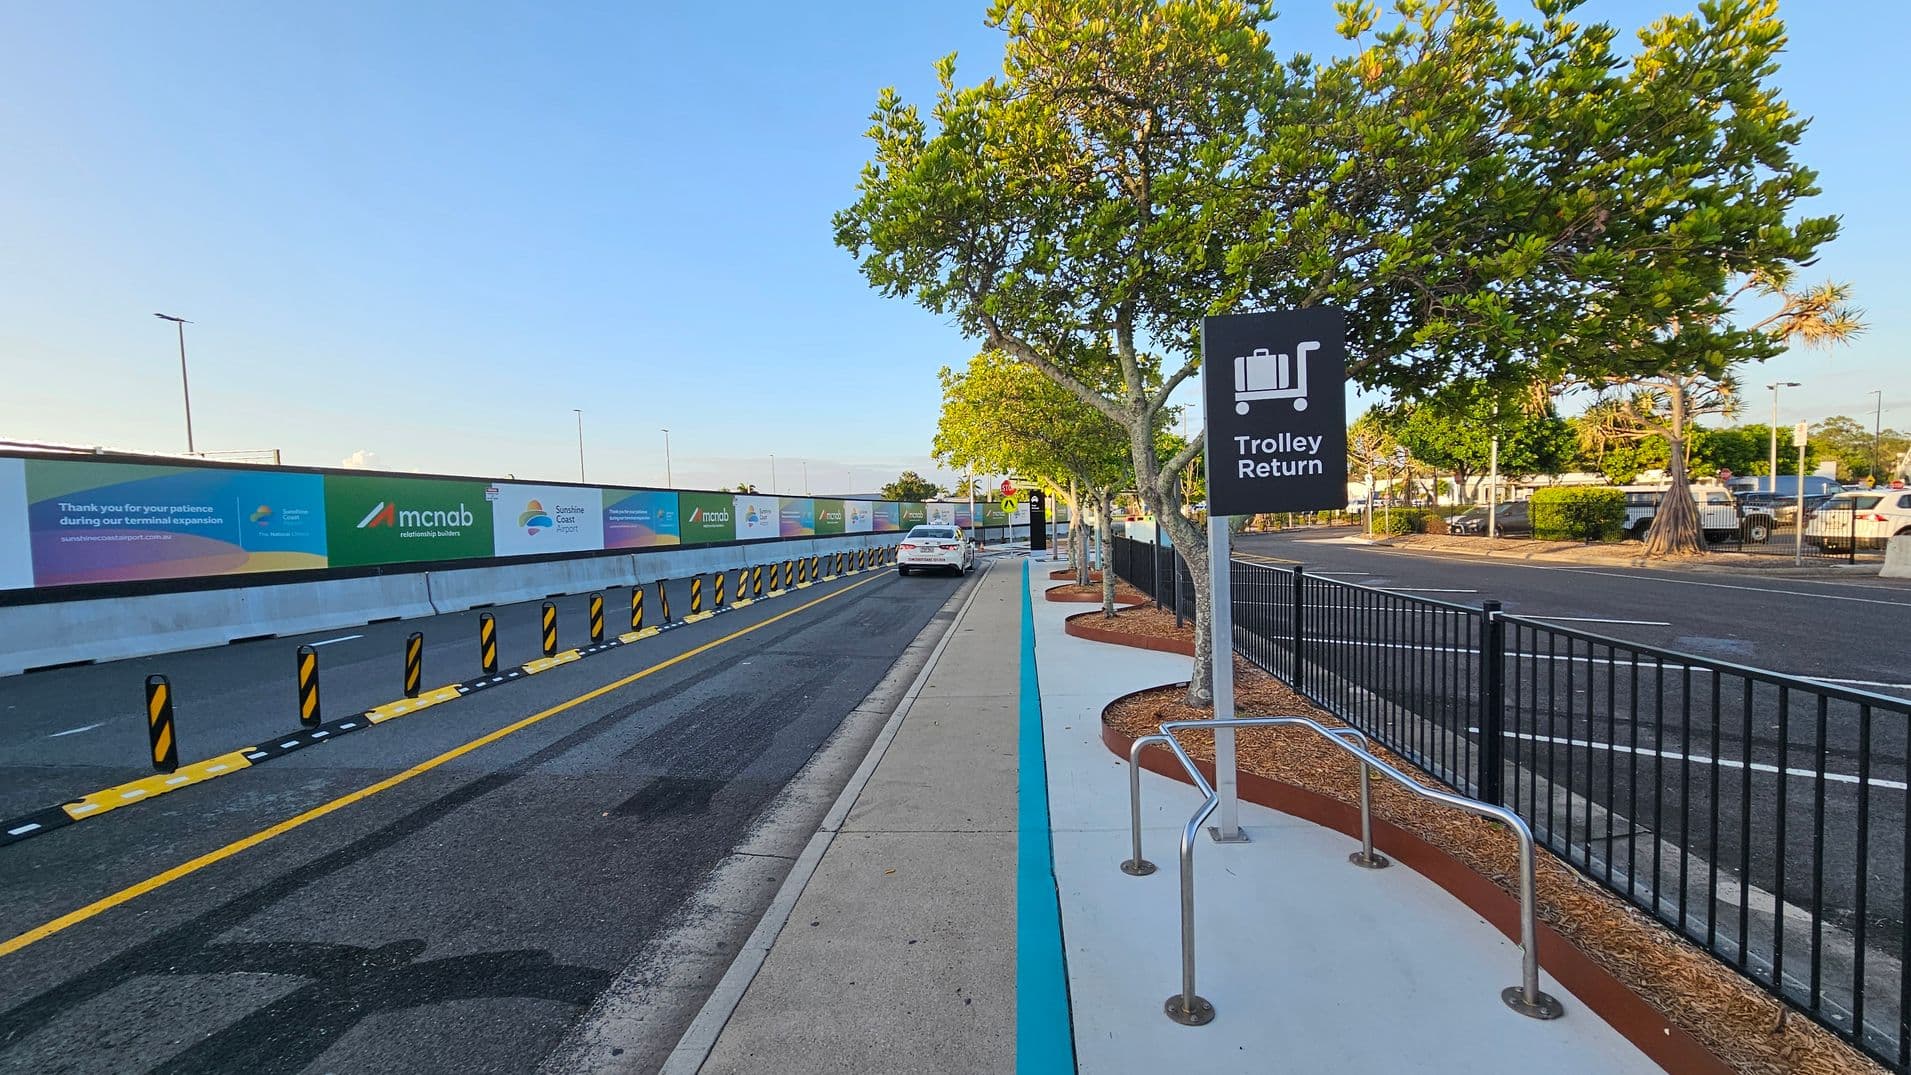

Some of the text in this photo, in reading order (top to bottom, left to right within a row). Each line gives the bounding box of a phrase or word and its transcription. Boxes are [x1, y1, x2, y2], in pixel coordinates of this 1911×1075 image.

[1234, 432, 1323, 455] Trolley
[1238, 459, 1323, 478] Return
[58, 502, 214, 514] Thank you for your patience
[555, 505, 584, 514] Sunshine
[399, 503, 473, 527] mcnab
[556, 514, 575, 524] Coast
[702, 507, 729, 522] mcnab
[60, 515, 223, 527] during our terminal expansion
[400, 530, 436, 538] relationship
[556, 524, 579, 534] Airport
[61, 534, 172, 543] sunshinecoastairport.com.au
